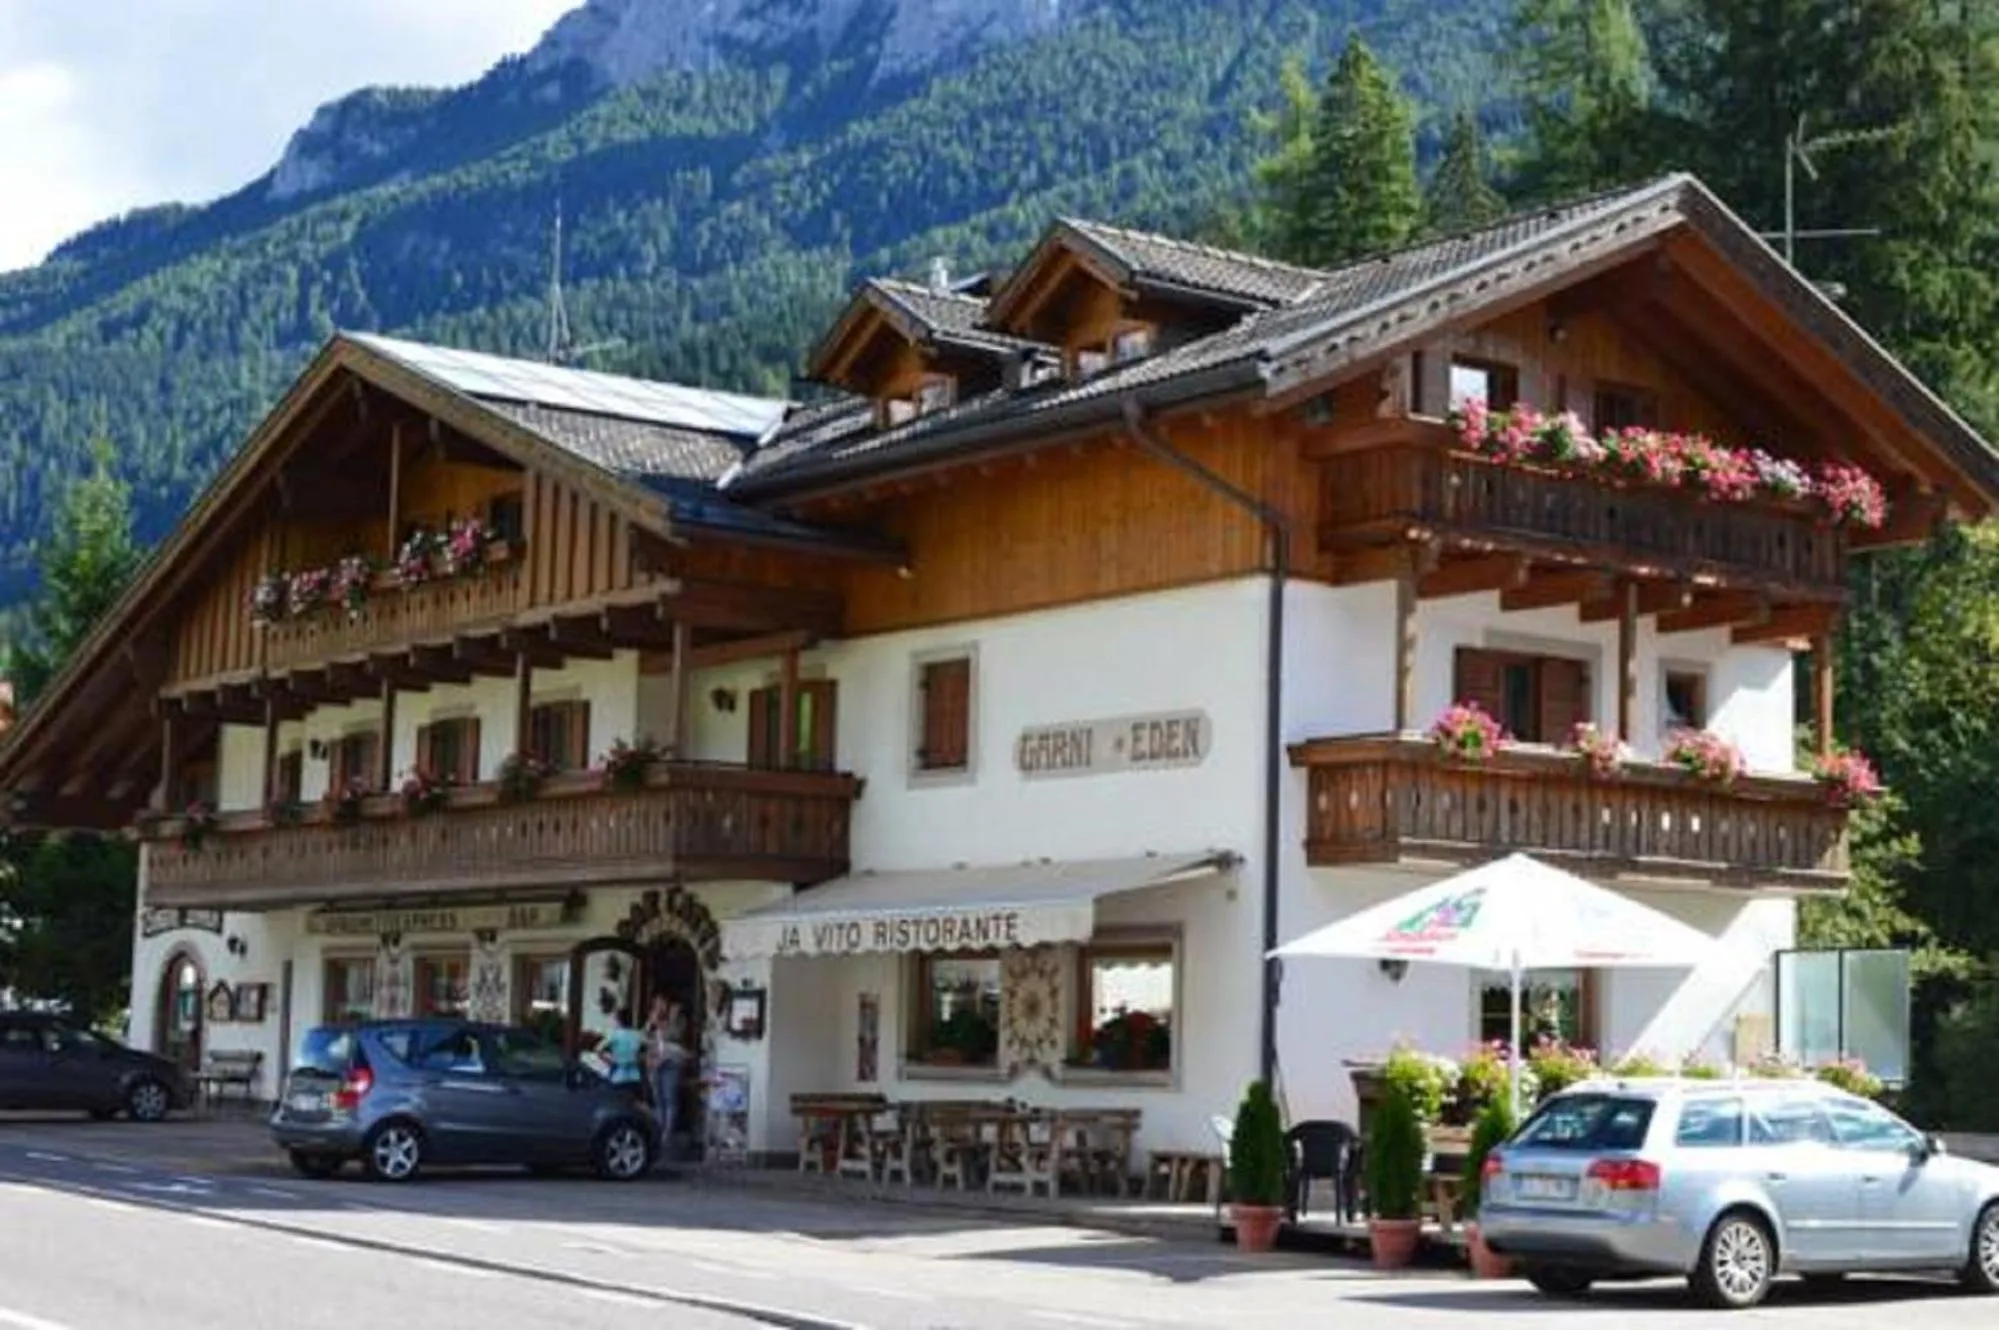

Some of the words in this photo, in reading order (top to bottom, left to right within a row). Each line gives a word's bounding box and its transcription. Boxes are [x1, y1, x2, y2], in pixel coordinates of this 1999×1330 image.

[1018, 727, 1093, 771] GARNI
[1130, 718, 1200, 761] EDEN
[813, 921, 862, 949] VITO
[873, 911, 1018, 946] RISTORANTE
